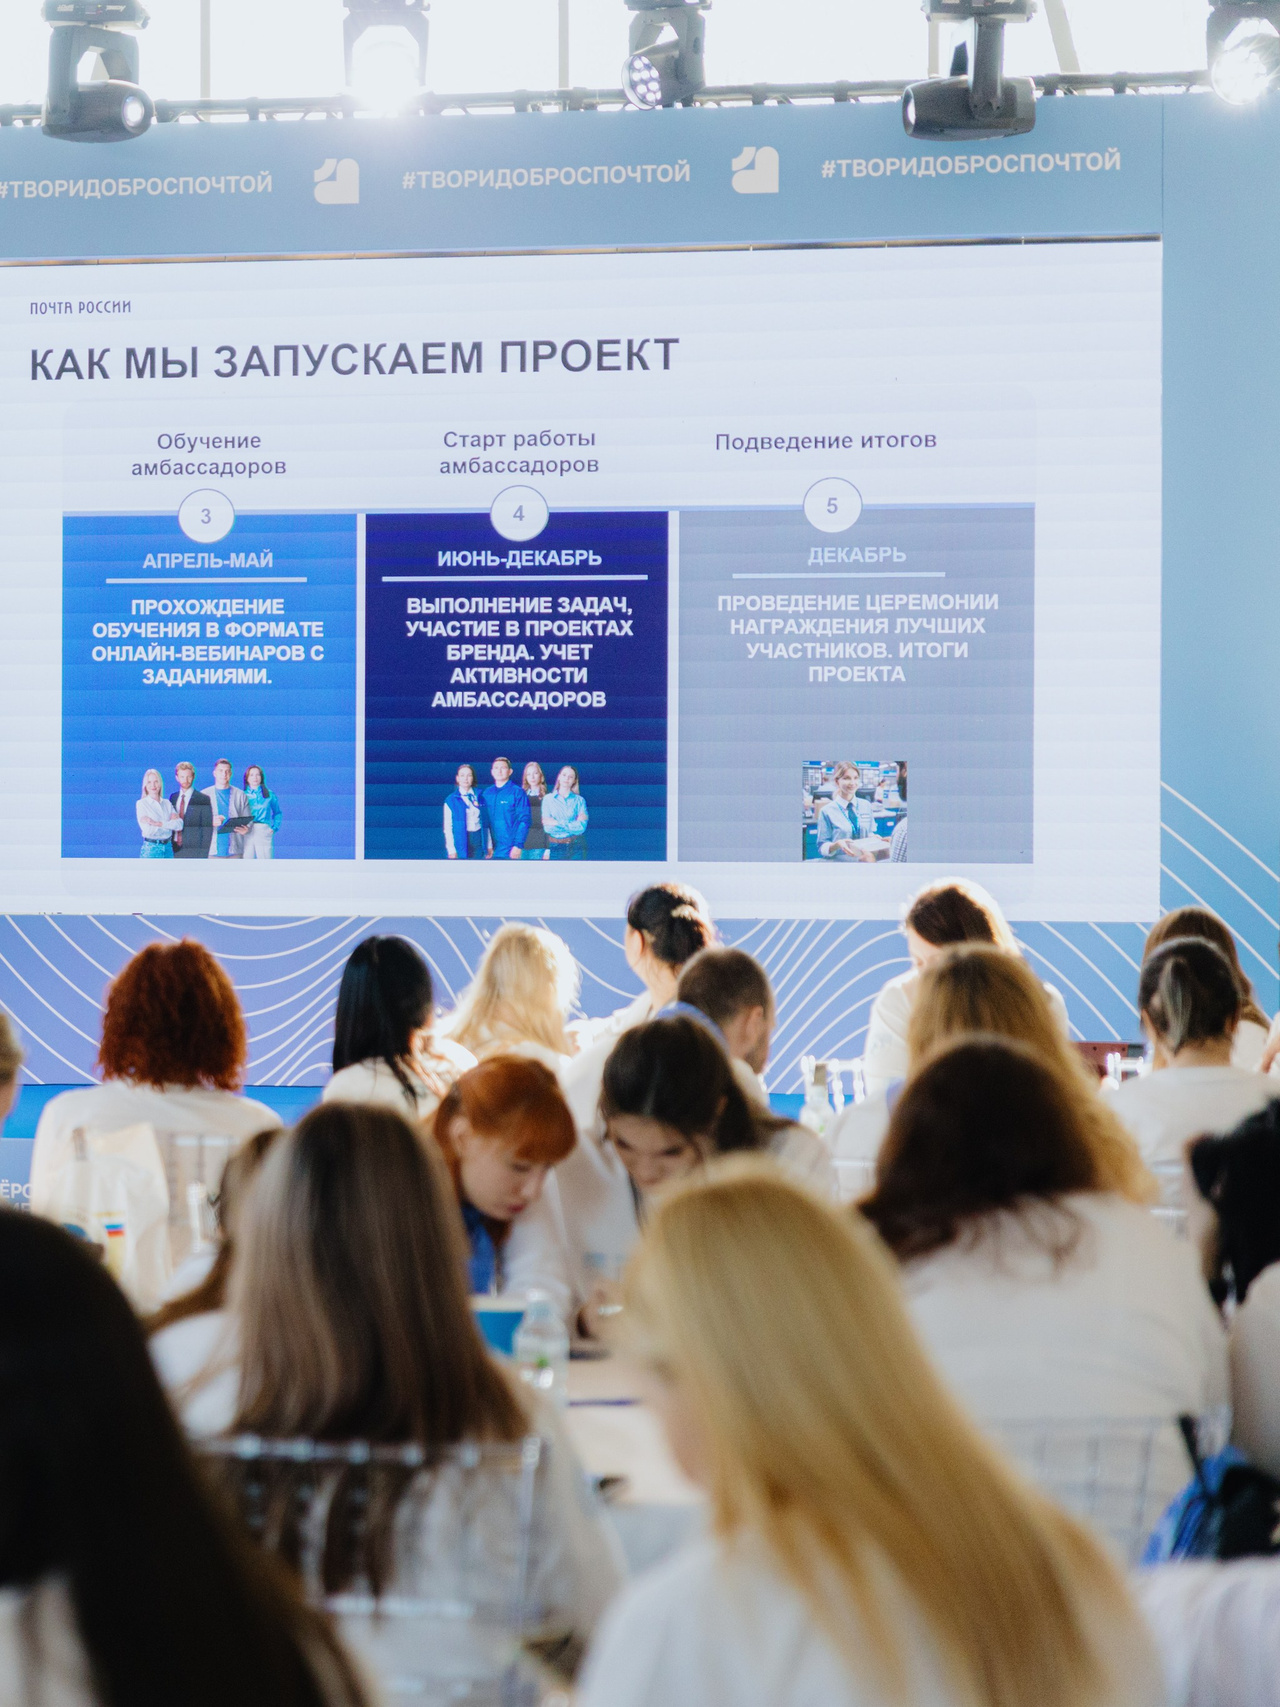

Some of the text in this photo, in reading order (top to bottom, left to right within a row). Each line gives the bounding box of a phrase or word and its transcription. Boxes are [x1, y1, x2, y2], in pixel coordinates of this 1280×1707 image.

[821, 148, 1121, 178] #ТВОРИДОБРОСПОЧТОЙ
[402, 160, 691, 189] #ТВОРИДОБРОСПОЧТОЙ
[29, 300, 132, 316] ПОЧТА РОССИИ
[30, 337, 681, 381] КАК МЫ ЗАПУСКАЕМ ПРОЕКТ
[156, 432, 262, 453] Обучение
[443, 430, 596, 450] Старт работы
[715, 433, 937, 453] Подведение итогов
[131, 458, 287, 478] амбассадоров
[439, 456, 600, 477] амбассадоров
[512, 505, 525, 521] 4
[826, 497, 838, 514] 5
[201, 508, 211, 524] 3
[142, 549, 273, 569] АПРЕЛЬ-МАЙ
[437, 550, 603, 568] ИЮНЬ-ДЕКАБРЬ
[808, 547, 907, 565] ДЕКАБРЬ
[131, 599, 284, 617] ПРОХОЖДЕНИЕ
[407, 597, 633, 615] ВЫПОЛНЕНИЕ ЗАДАЧ,
[718, 594, 999, 613] ПРОВЕДЕНИЕ ЦЕРЕМОНИИ
[92, 621, 324, 638] ОБУЧЕНИЯ В ФОРМАТЕ
[406, 620, 634, 637] УЧАСТИЕ В ПРОЕКТАХ
[730, 617, 986, 637] НАГРАЖДЕНИЯ ЛУЧШИХ
[91, 642, 324, 661] ОНЛАЙН-ВЕБИНАРОВ С
[447, 643, 593, 662] БРЕНДА. УЧЕТ
[746, 642, 969, 660] УЧАСТНИКОВ. ИТОГИ
[142, 669, 272, 686] ЗАДАНИЯМИ.
[450, 667, 588, 684] АКТИВНОСТИ
[809, 666, 907, 682] ПРОЕКТА
[431, 691, 607, 710] АМБАССАДОРОВ
